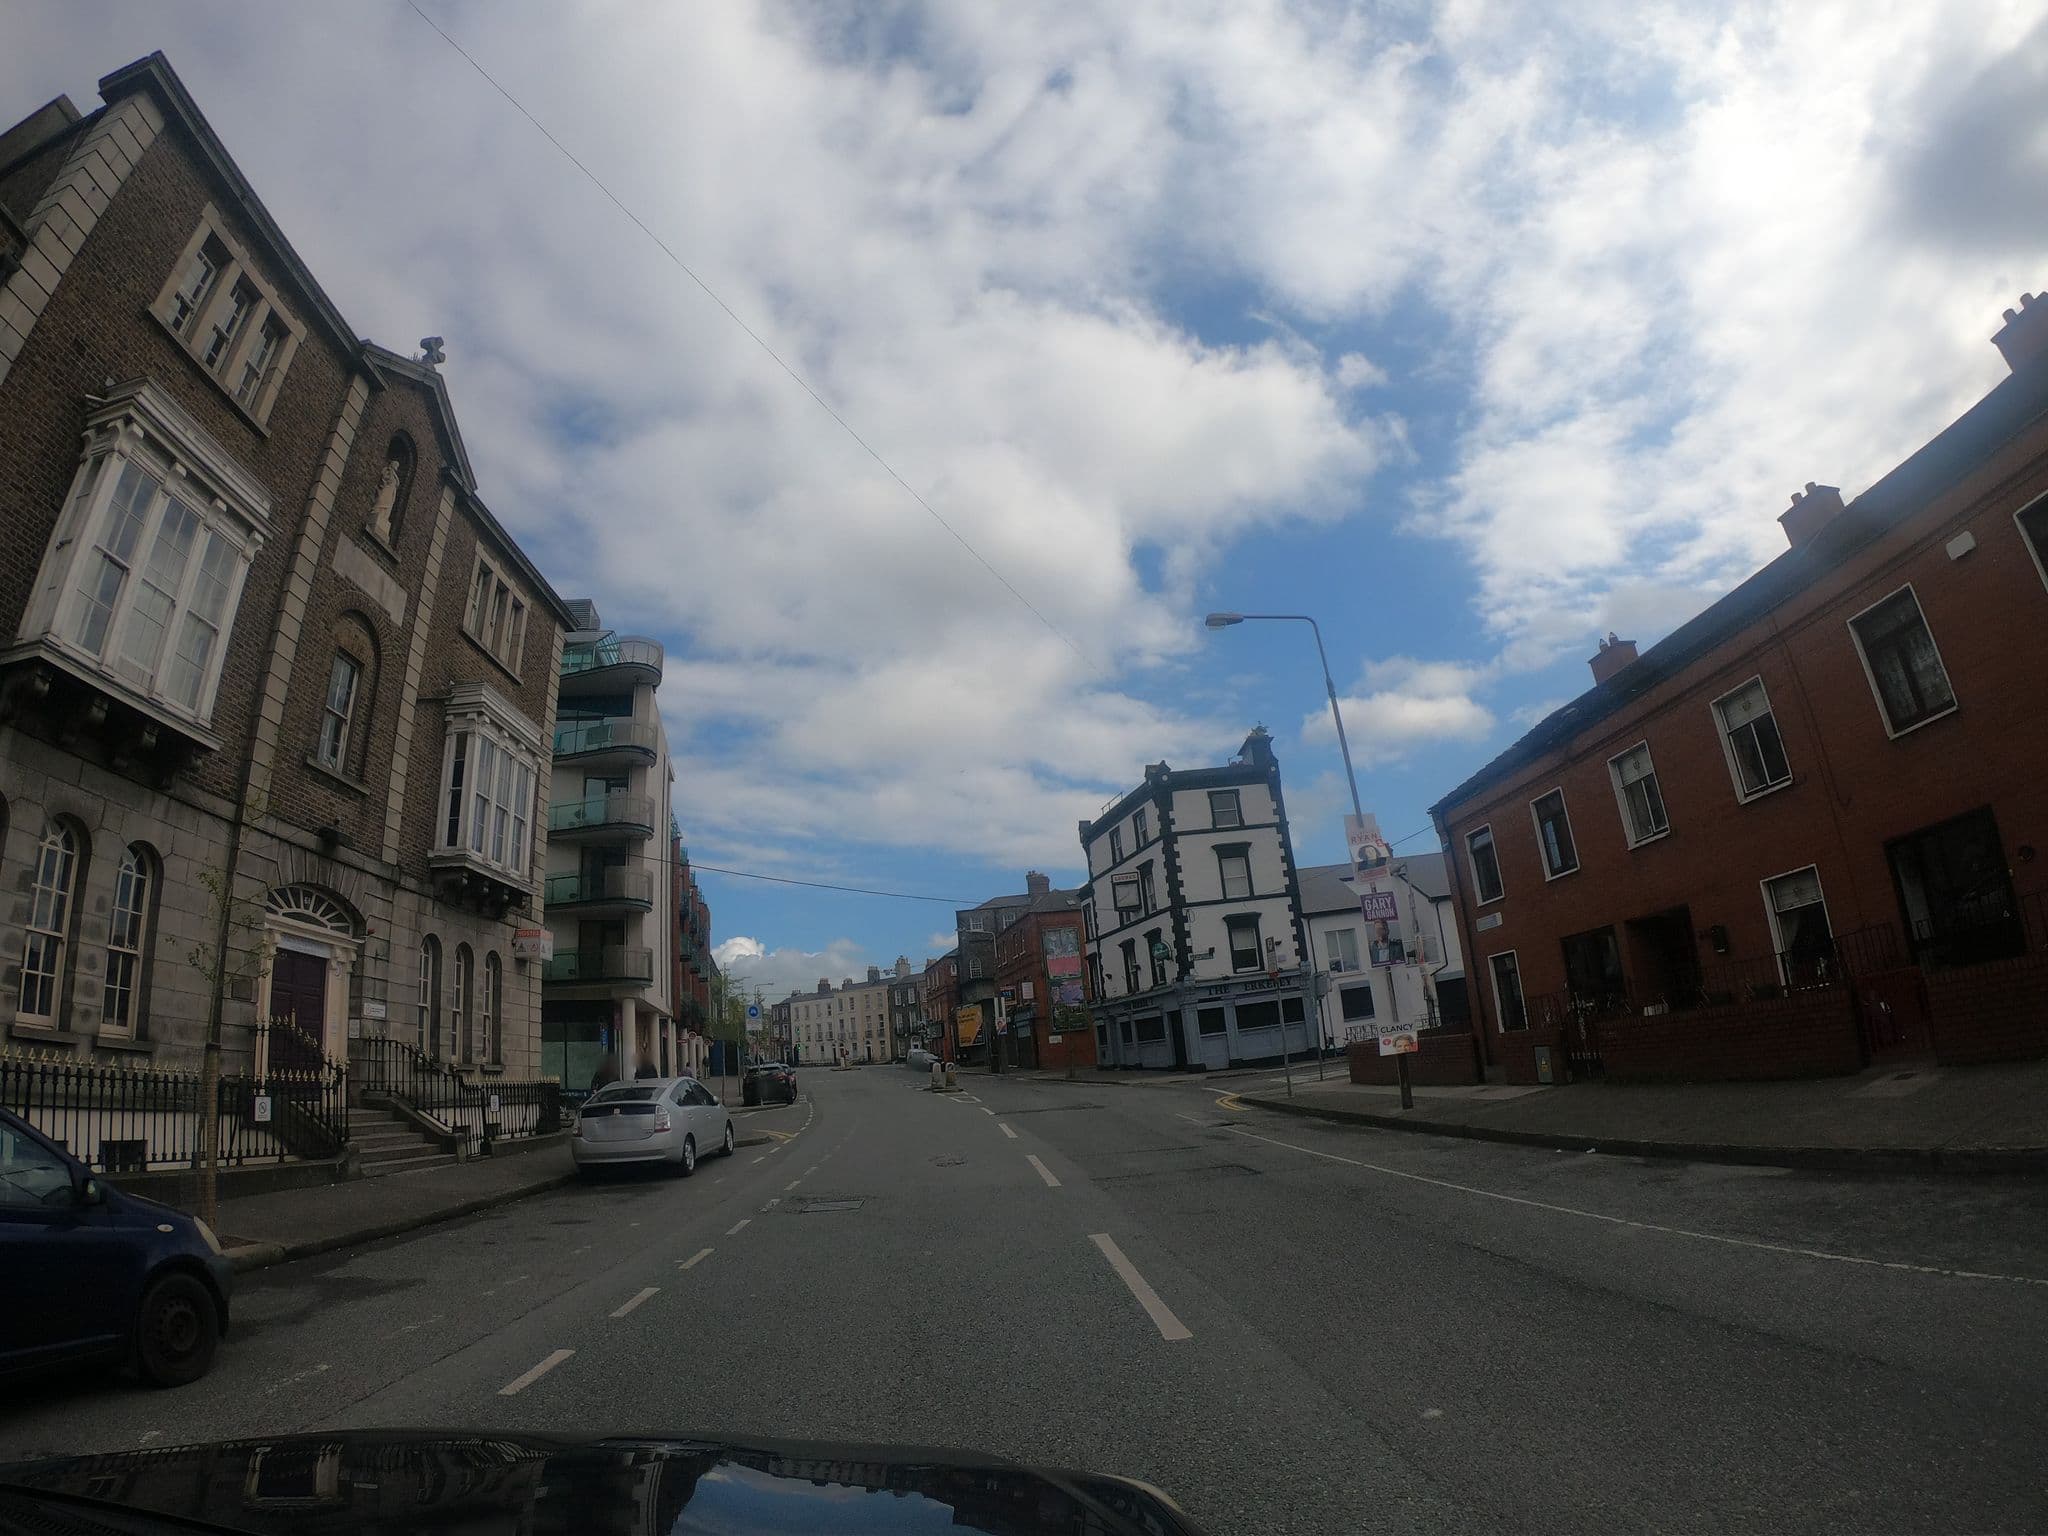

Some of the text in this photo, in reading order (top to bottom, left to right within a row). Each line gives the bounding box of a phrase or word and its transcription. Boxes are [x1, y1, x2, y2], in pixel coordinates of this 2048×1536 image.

[1351, 833, 1379, 844] RYAN
[1364, 896, 1392, 911] GARY
[1366, 908, 1396, 920] GANNON
[1208, 983, 1231, 996] THE
[1380, 1023, 1414, 1034] CLANCY
